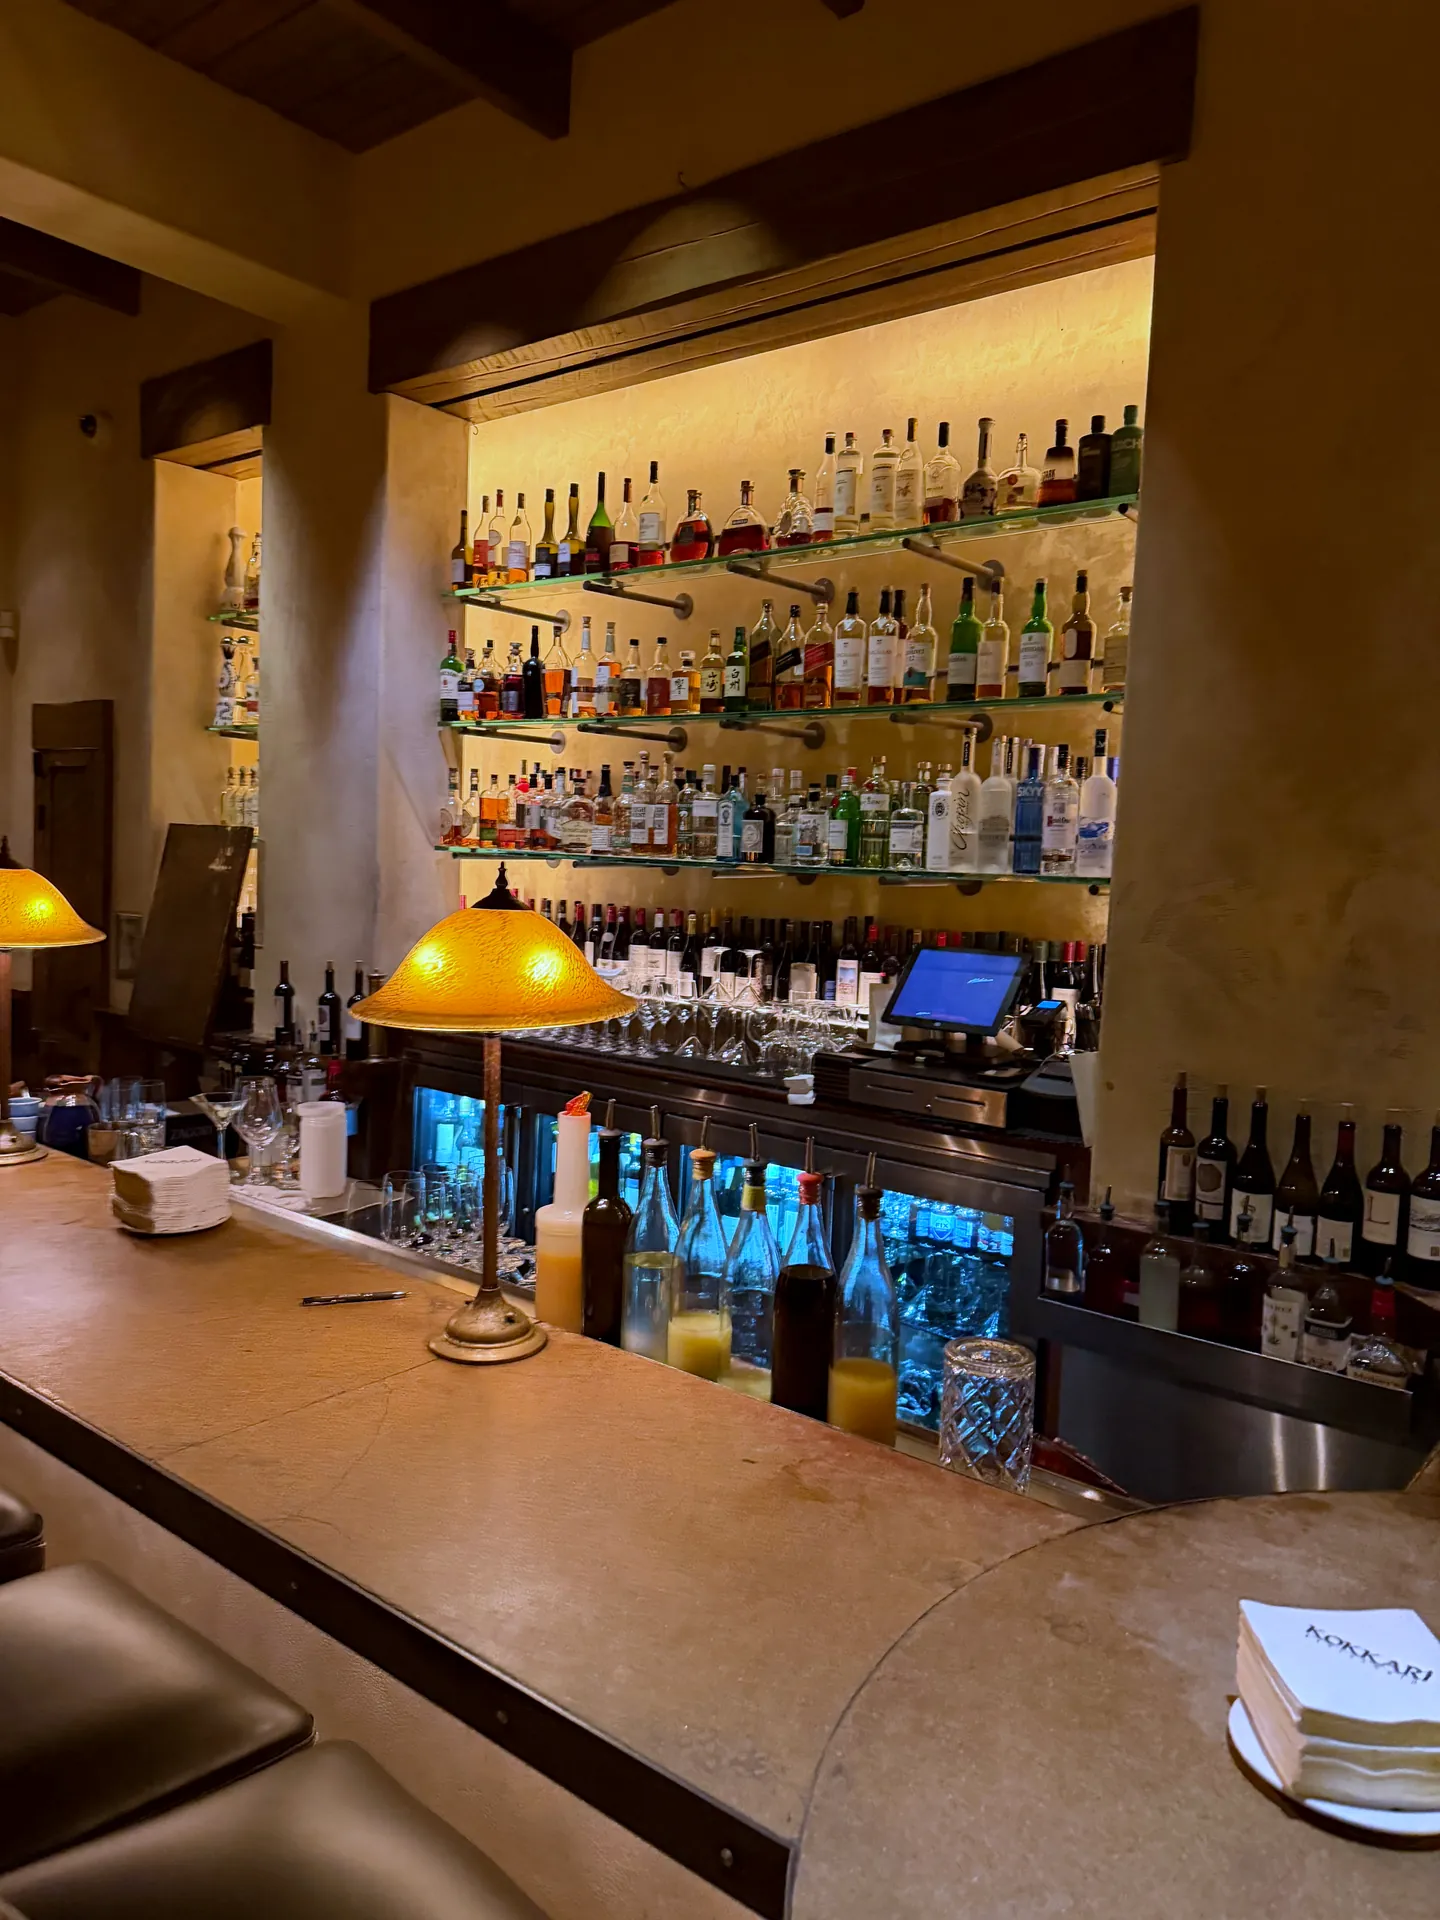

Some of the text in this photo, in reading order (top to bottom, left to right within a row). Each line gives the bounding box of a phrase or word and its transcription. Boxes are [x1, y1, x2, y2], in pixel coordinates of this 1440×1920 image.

[949, 788, 970, 851] Chopin
[1017, 786, 1044, 797] SKYY
[1305, 1624, 1434, 1684] KOKKARI
